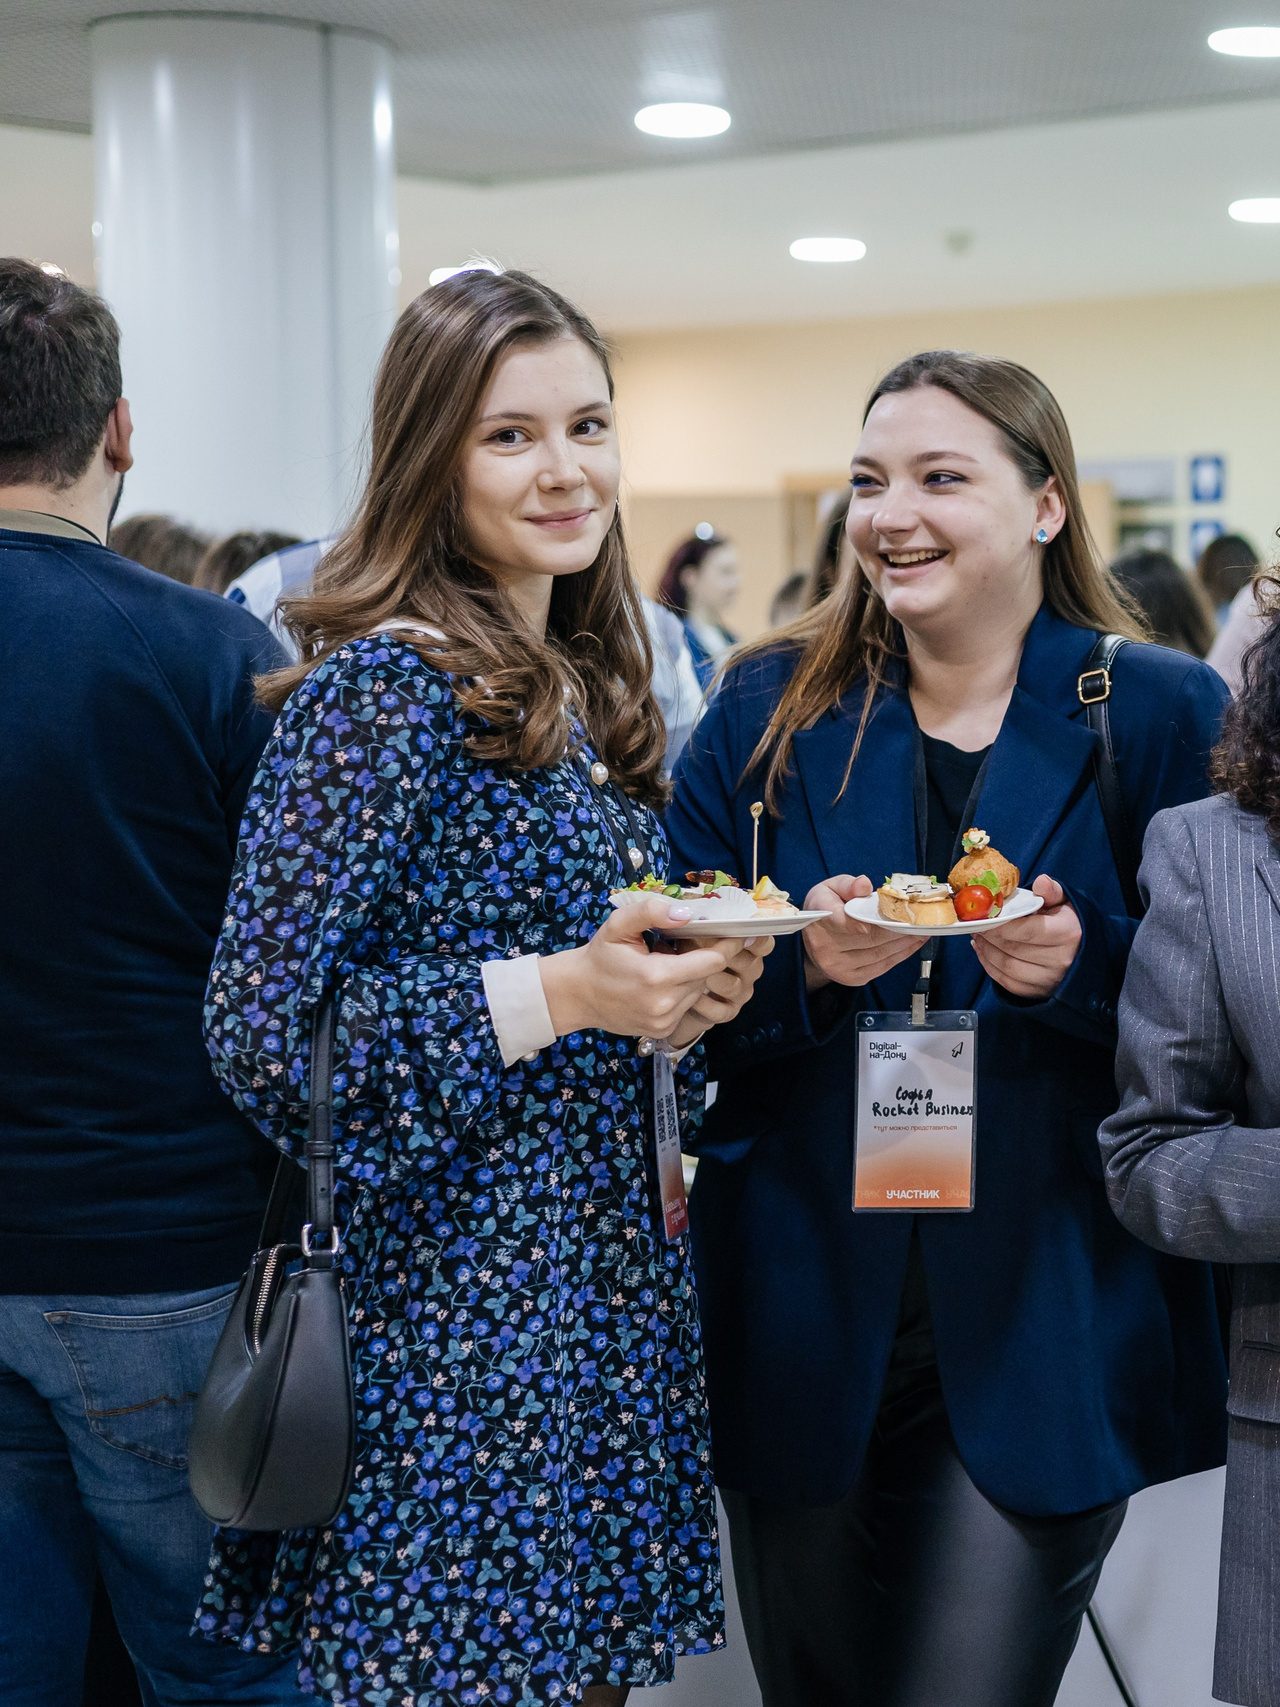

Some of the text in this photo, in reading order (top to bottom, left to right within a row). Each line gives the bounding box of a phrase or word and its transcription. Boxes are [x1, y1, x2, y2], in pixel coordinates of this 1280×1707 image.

[869, 1042, 902, 1052] Digital-
[869, 1051, 907, 1061] на-Дону
[872, 1102, 919, 1117] Rocket
[886, 1190, 940, 1199] УЧАСТНИК
